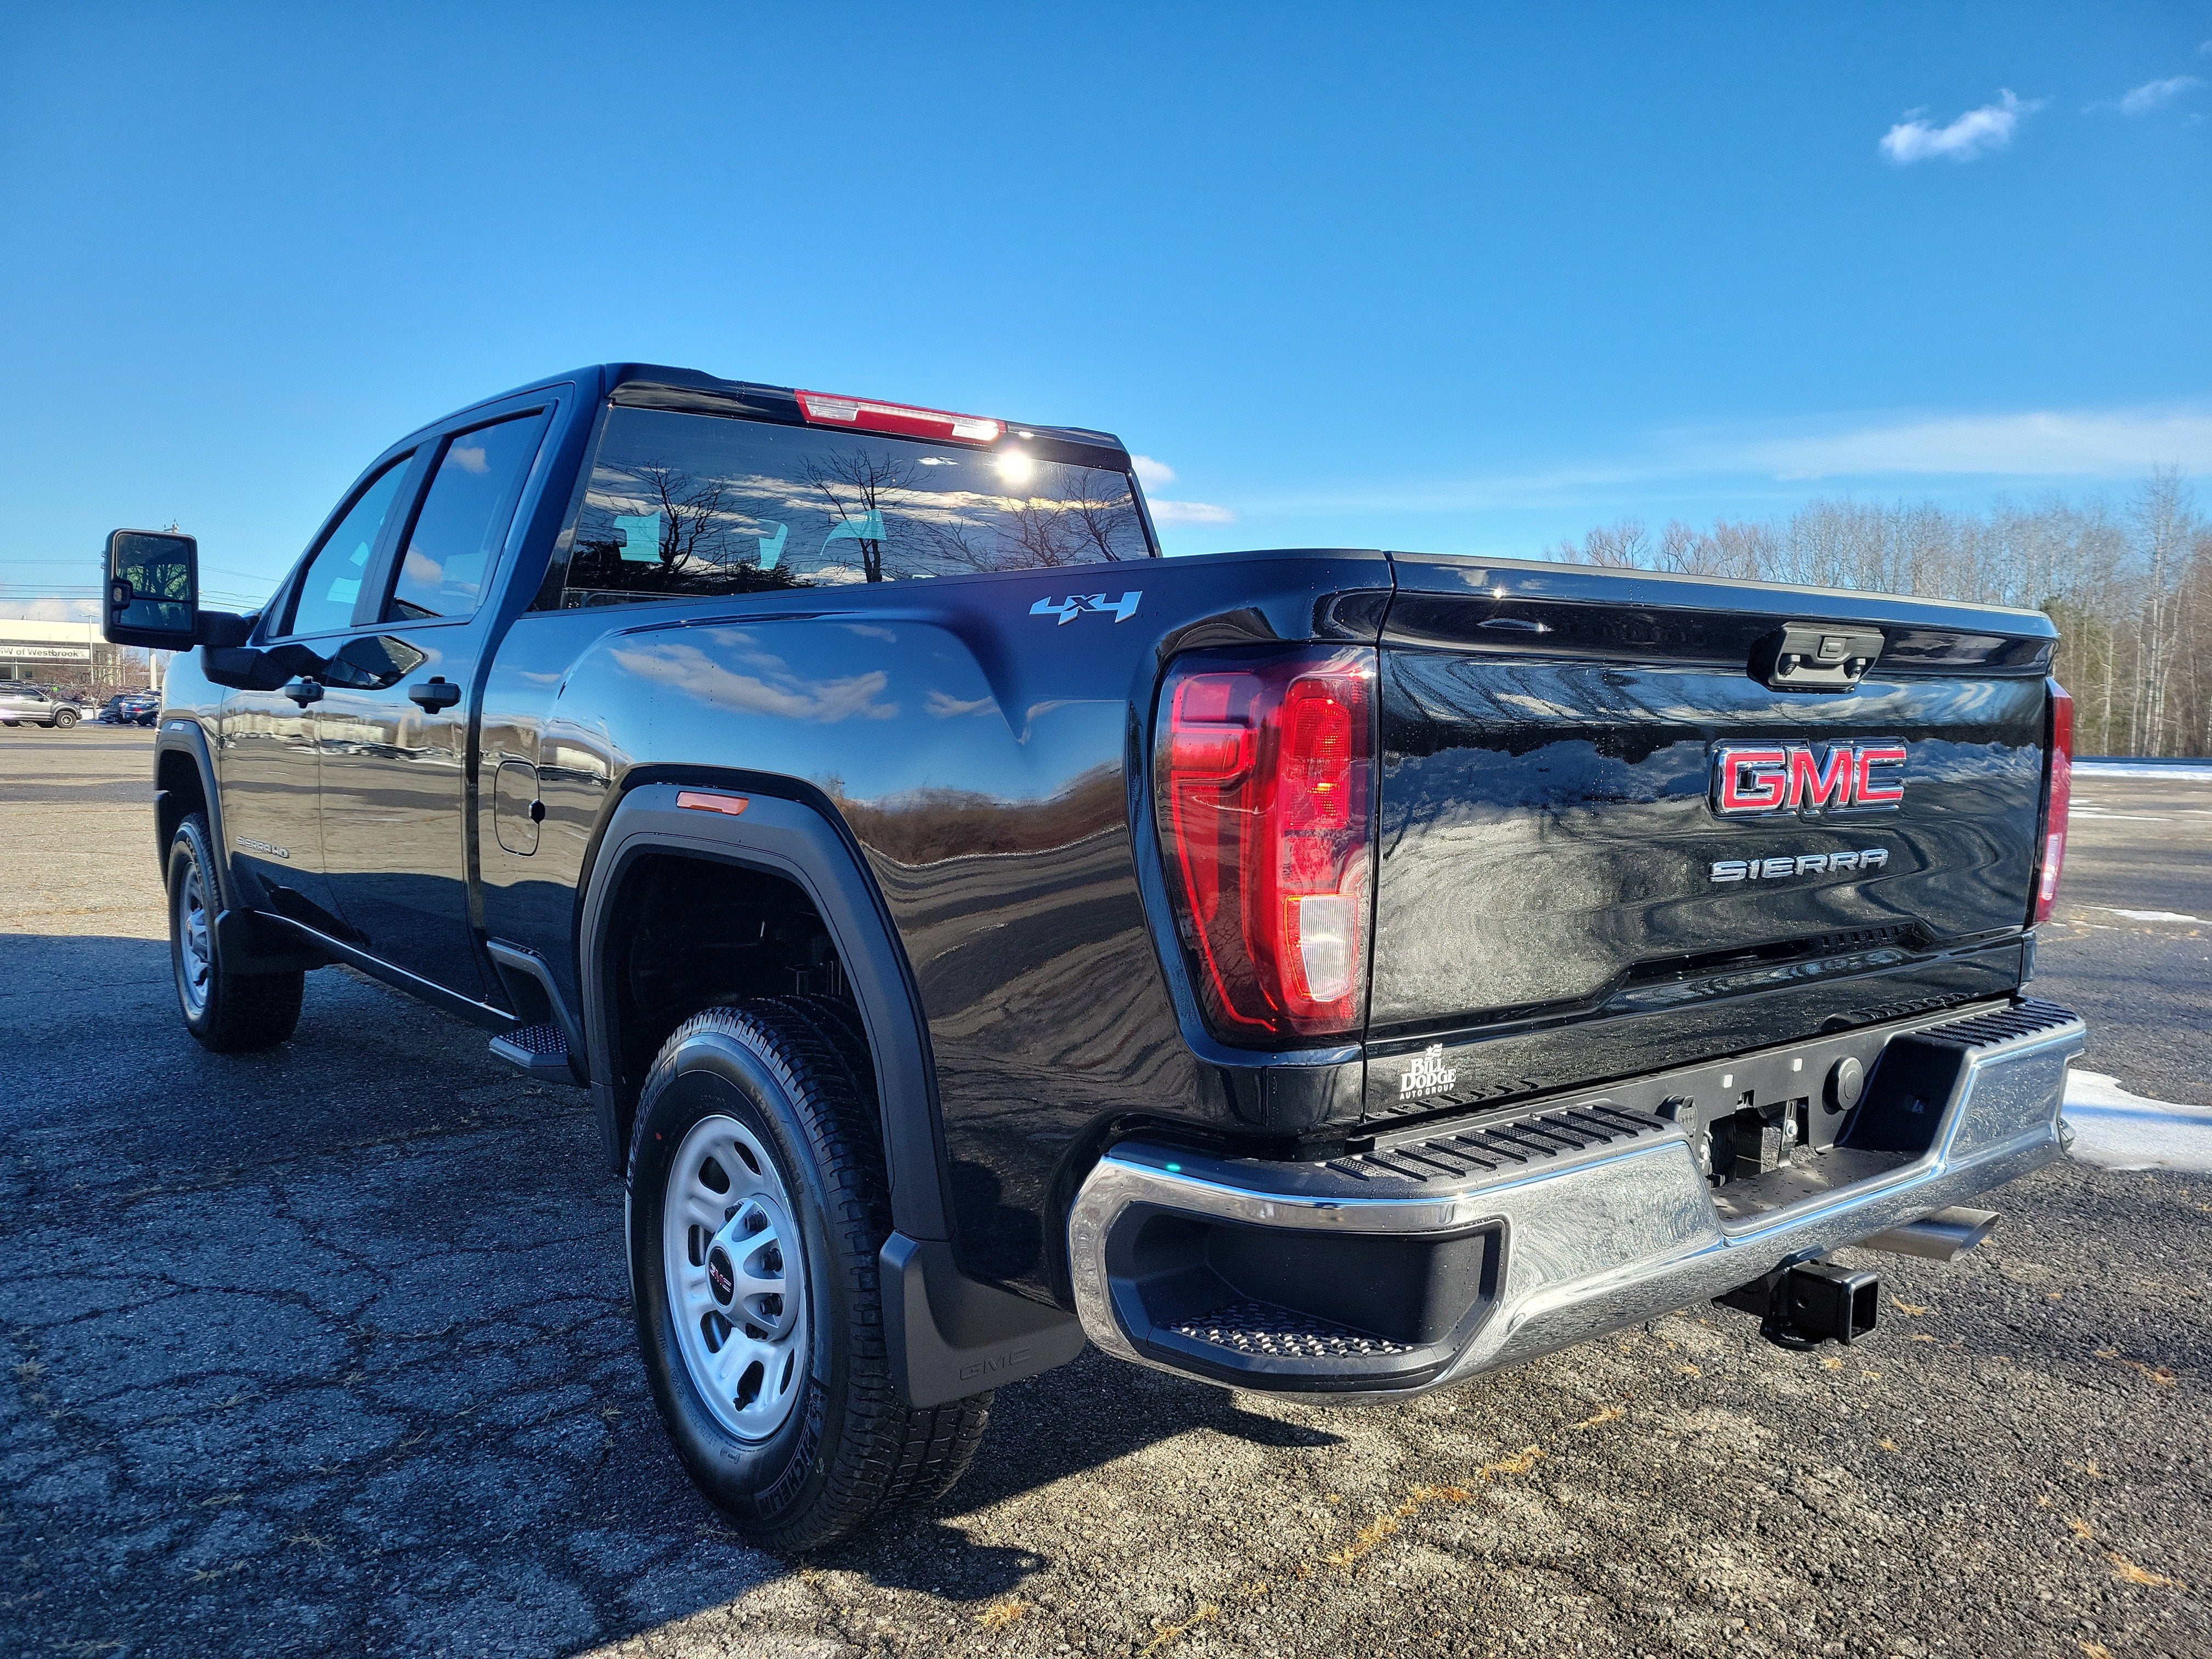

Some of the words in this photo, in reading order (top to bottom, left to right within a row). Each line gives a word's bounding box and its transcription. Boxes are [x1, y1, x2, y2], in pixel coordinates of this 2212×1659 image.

[27, 648, 79, 657] Westbrook
[1709, 742, 1908, 819] GMC
[1709, 848, 1889, 883] SIERRA
[1410, 1057, 1446, 1077] BILL
[1399, 1089, 1423, 1101] AUTO
[1425, 1083, 1455, 1095] GROUP
[1400, 1069, 1457, 1092] DODGE
[960, 1345, 1032, 1381] GMC
